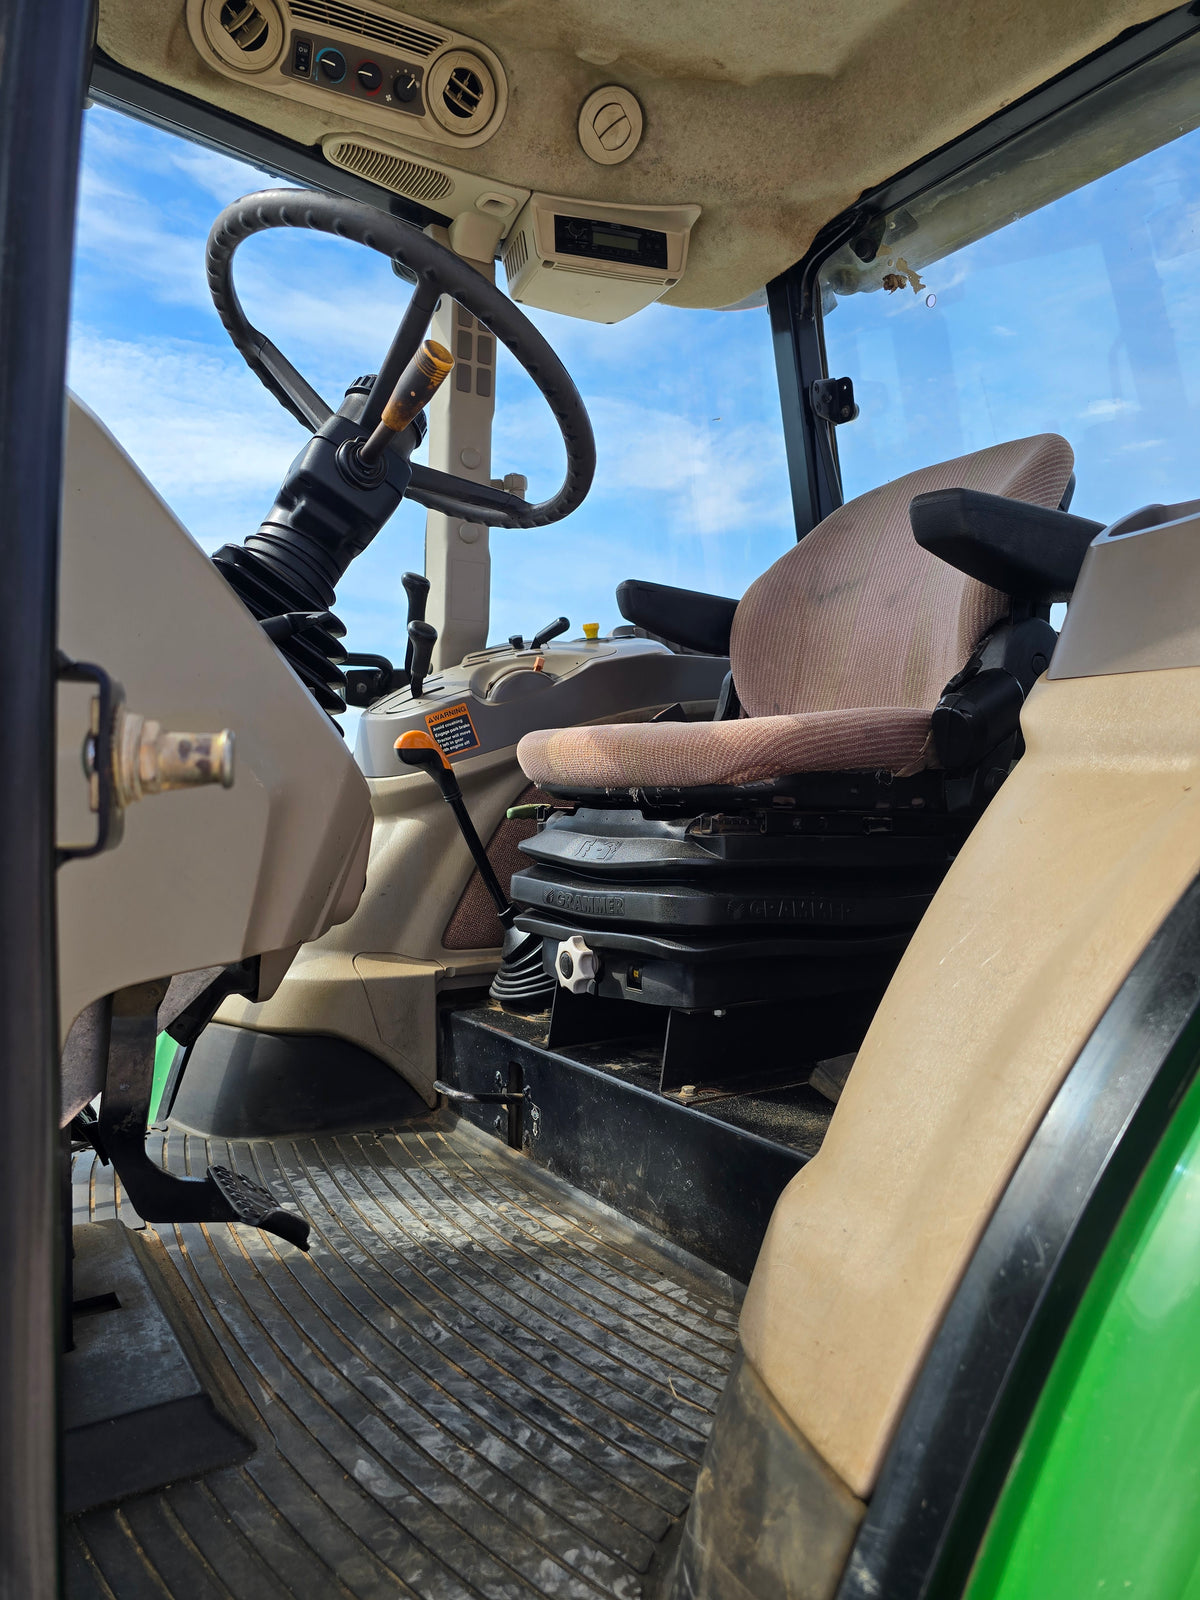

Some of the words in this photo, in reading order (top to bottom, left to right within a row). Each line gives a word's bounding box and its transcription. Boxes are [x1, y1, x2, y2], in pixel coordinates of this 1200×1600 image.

[433, 706, 467, 721] WARNING
[433, 724, 445, 732] Avoid
[445, 718, 463, 728] crushing
[435, 729, 450, 738] Engage
[557, 889, 625, 915] GRAMMER
